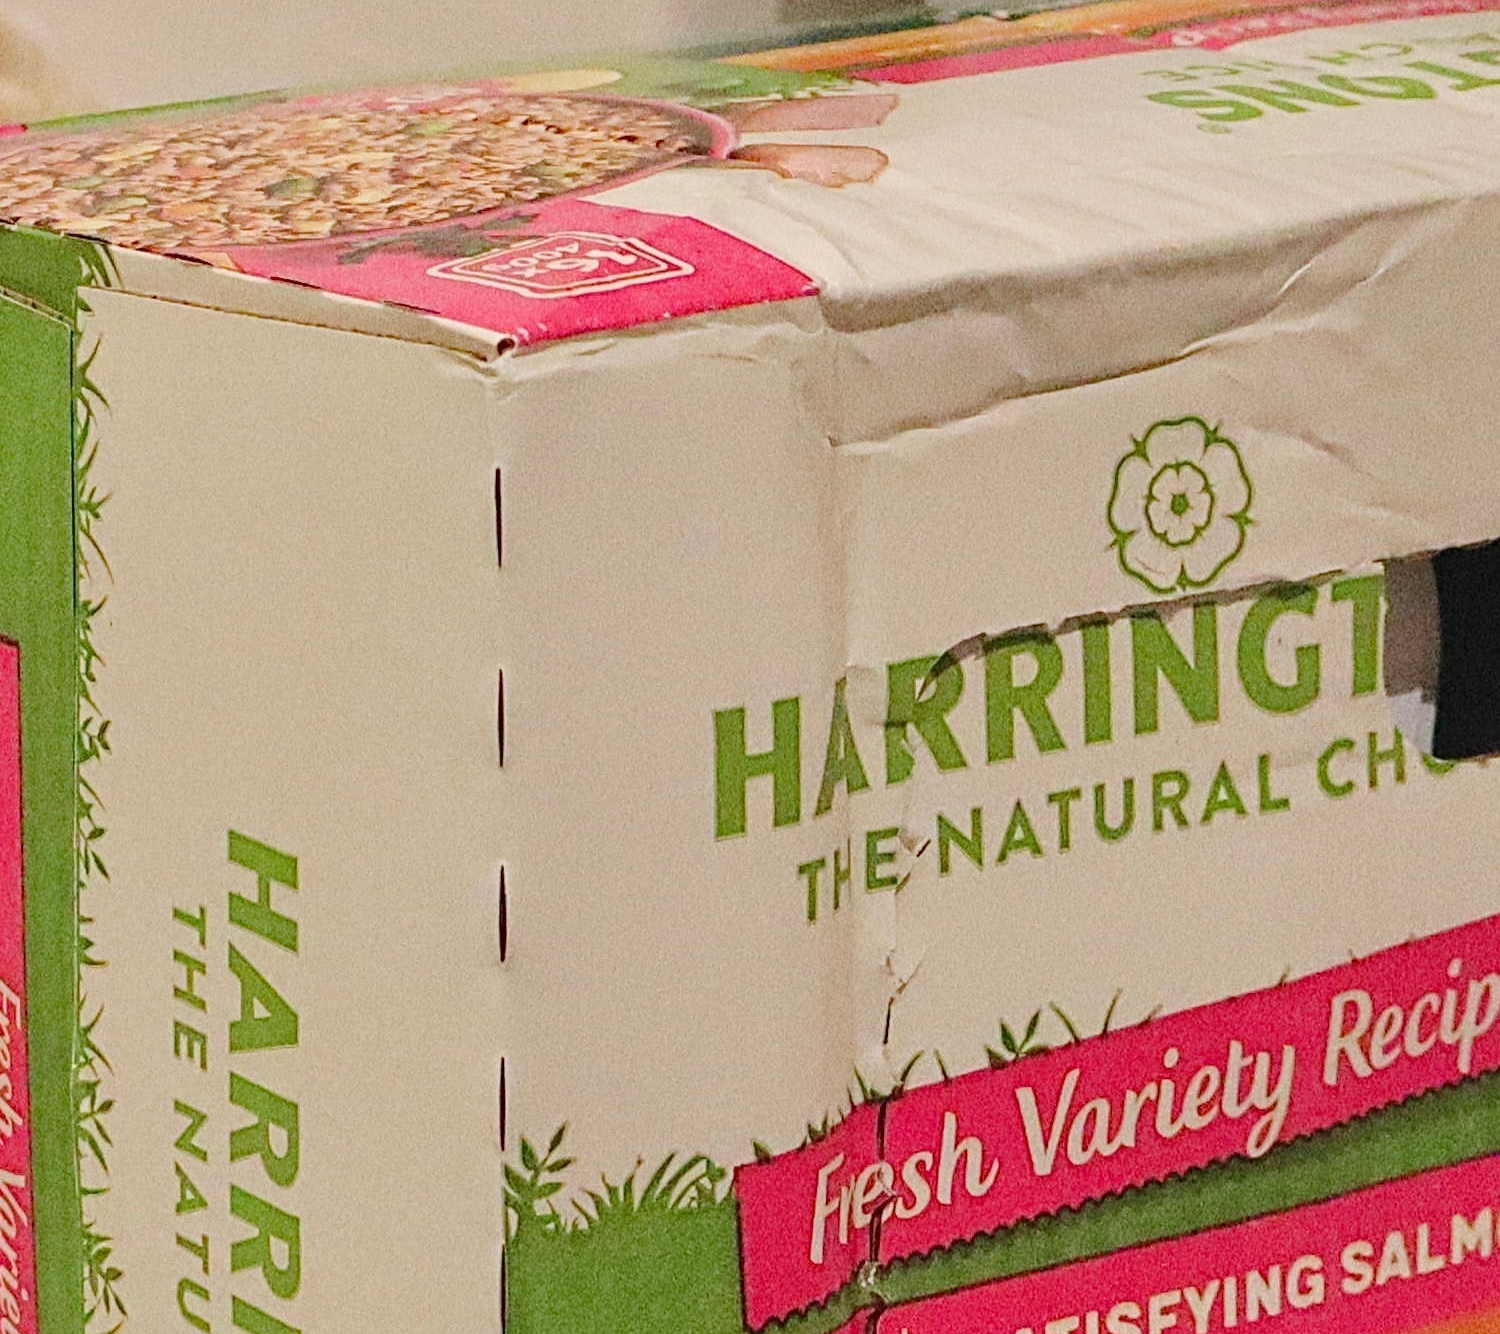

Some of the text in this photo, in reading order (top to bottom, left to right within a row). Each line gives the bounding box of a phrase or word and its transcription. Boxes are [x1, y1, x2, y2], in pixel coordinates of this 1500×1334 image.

[713, 573, 1385, 842] HARRINGT
[798, 839, 901, 924] THE
[936, 757, 1293, 879] NATURAL
[172, 904, 208, 1072] THE
[808, 1107, 1000, 1265] Fresh
[1012, 1031, 1299, 1181] Variety
